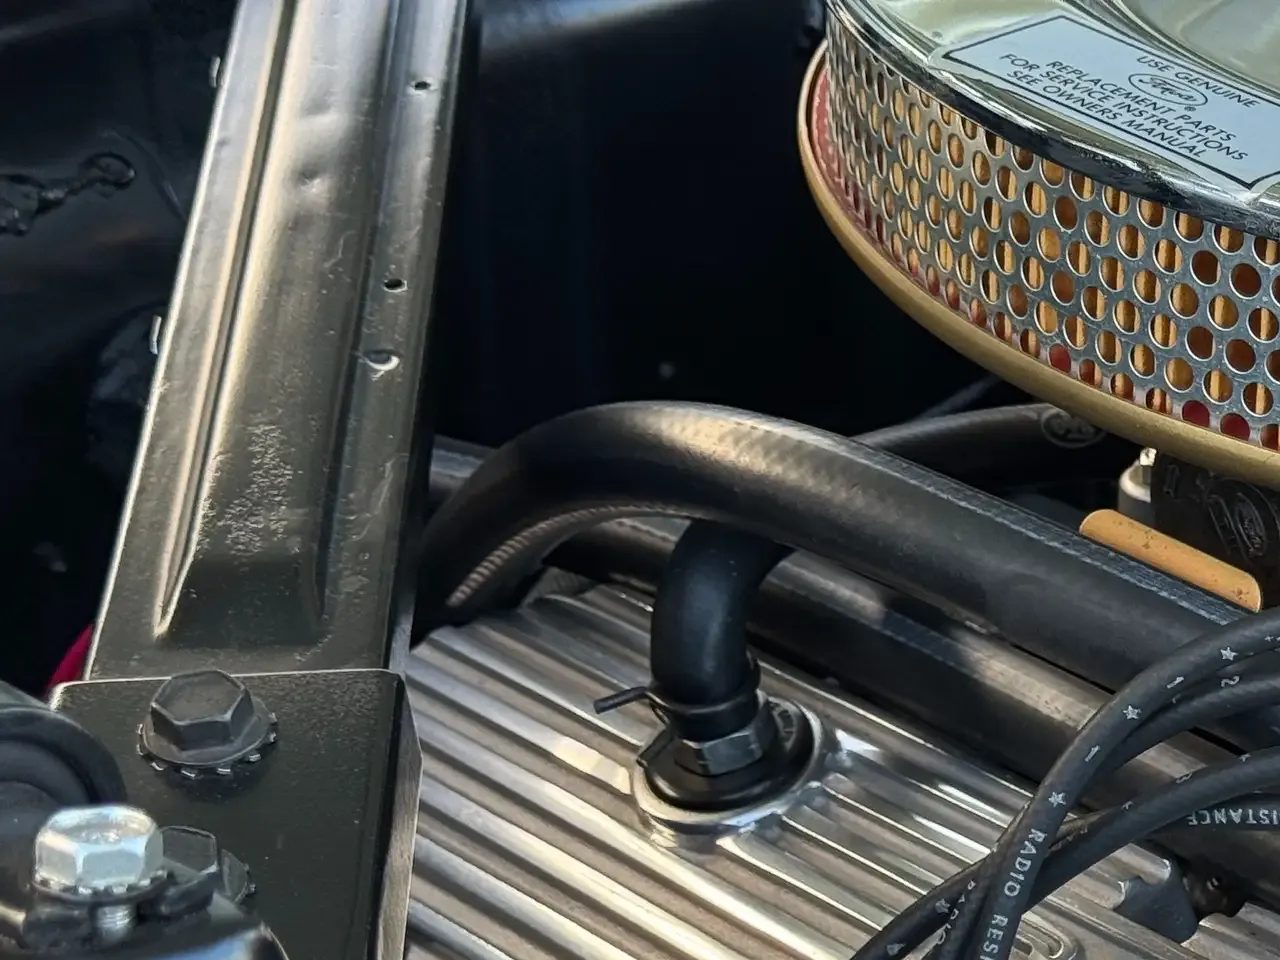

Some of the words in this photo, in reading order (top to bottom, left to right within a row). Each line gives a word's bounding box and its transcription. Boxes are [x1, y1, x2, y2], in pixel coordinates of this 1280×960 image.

[1000, 54, 1040, 71] FOR
[1040, 70, 1115, 103] SERVICE
[1112, 102, 1248, 160] INSTRUCTIONS
[1007, 70, 1042, 86] SEE
[1043, 85, 1122, 120] OWNERS
[1121, 119, 1206, 157] MANUAL
[1046, 60, 1176, 115] REPLACEMENT
[1174, 114, 1236, 142] PARTS
[1137, 56, 1175, 72] USE
[1175, 71, 1260, 108] GENUINE
[1003, 828, 1047, 897] RADIO
